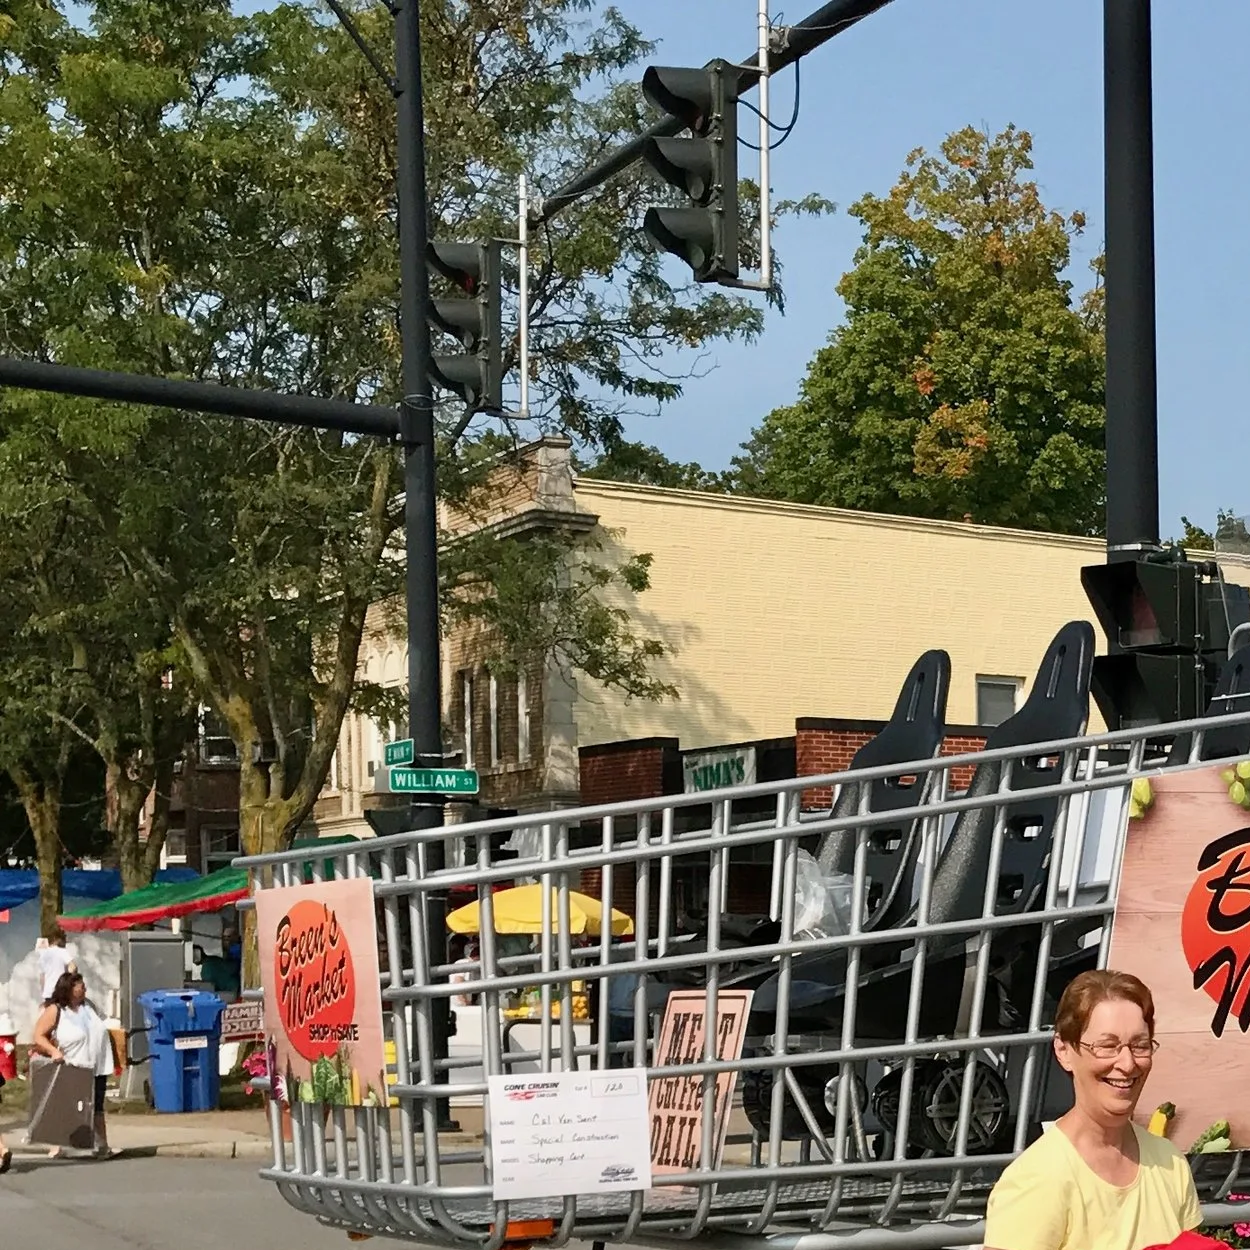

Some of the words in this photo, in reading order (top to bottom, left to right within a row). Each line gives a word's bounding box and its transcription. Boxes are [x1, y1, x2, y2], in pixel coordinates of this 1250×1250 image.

[394, 773, 456, 788] WILLIAM
[276, 903, 340, 978] Breen's
[281, 950, 348, 1028] Market
[309, 1023, 330, 1041] SHOP
[337, 1023, 360, 1041] SAVE
[678, 1077, 720, 1112] Freh
[531, 1133, 564, 1147] Special
[650, 1113, 702, 1168] DAIL
[527, 1152, 565, 1166] Shopping
